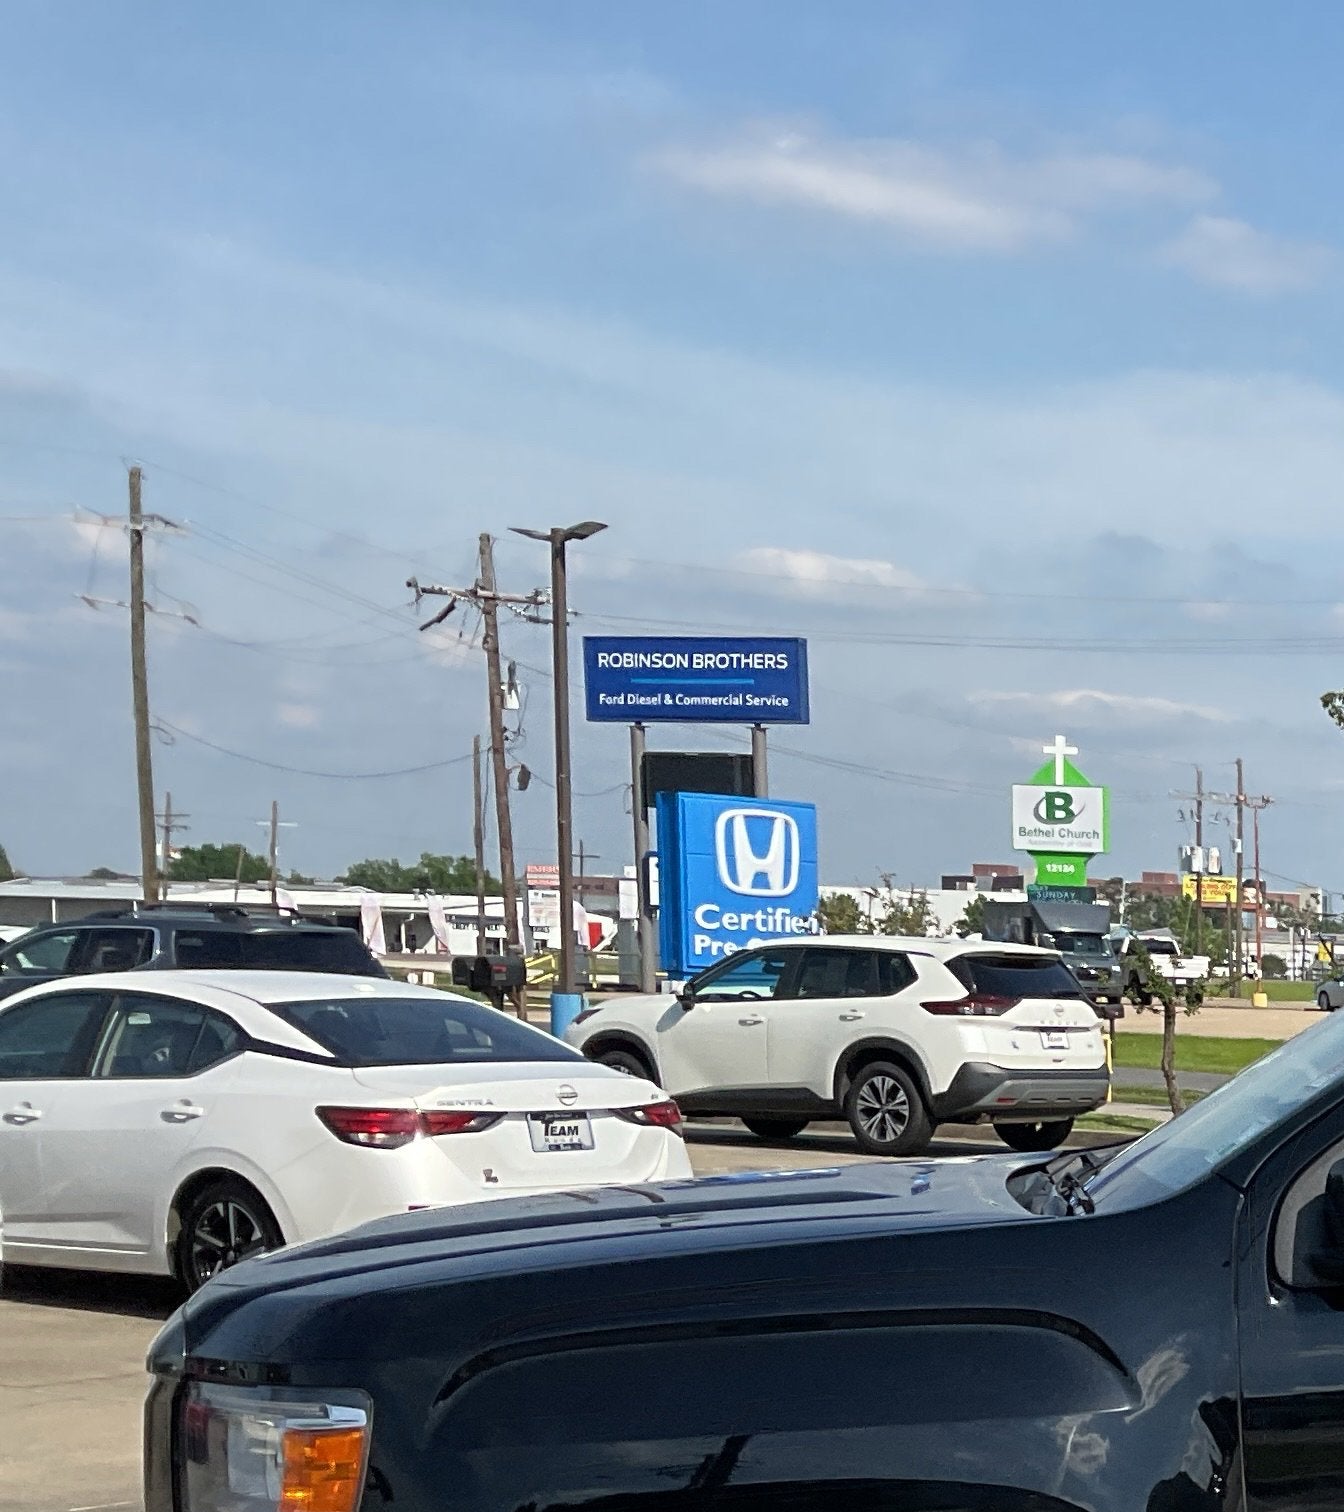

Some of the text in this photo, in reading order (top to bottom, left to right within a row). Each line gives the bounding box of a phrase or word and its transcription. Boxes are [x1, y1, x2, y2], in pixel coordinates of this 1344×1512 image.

[598, 652, 788, 670] ROBINSON BROTHERS
[599, 693, 789, 707] Ford Diesel & Commercial Service
[1045, 791, 1076, 821] B
[1018, 826, 1100, 840] Bethel Church
[1036, 891, 1076, 899] SUNDAY
[694, 903, 820, 934] Certified
